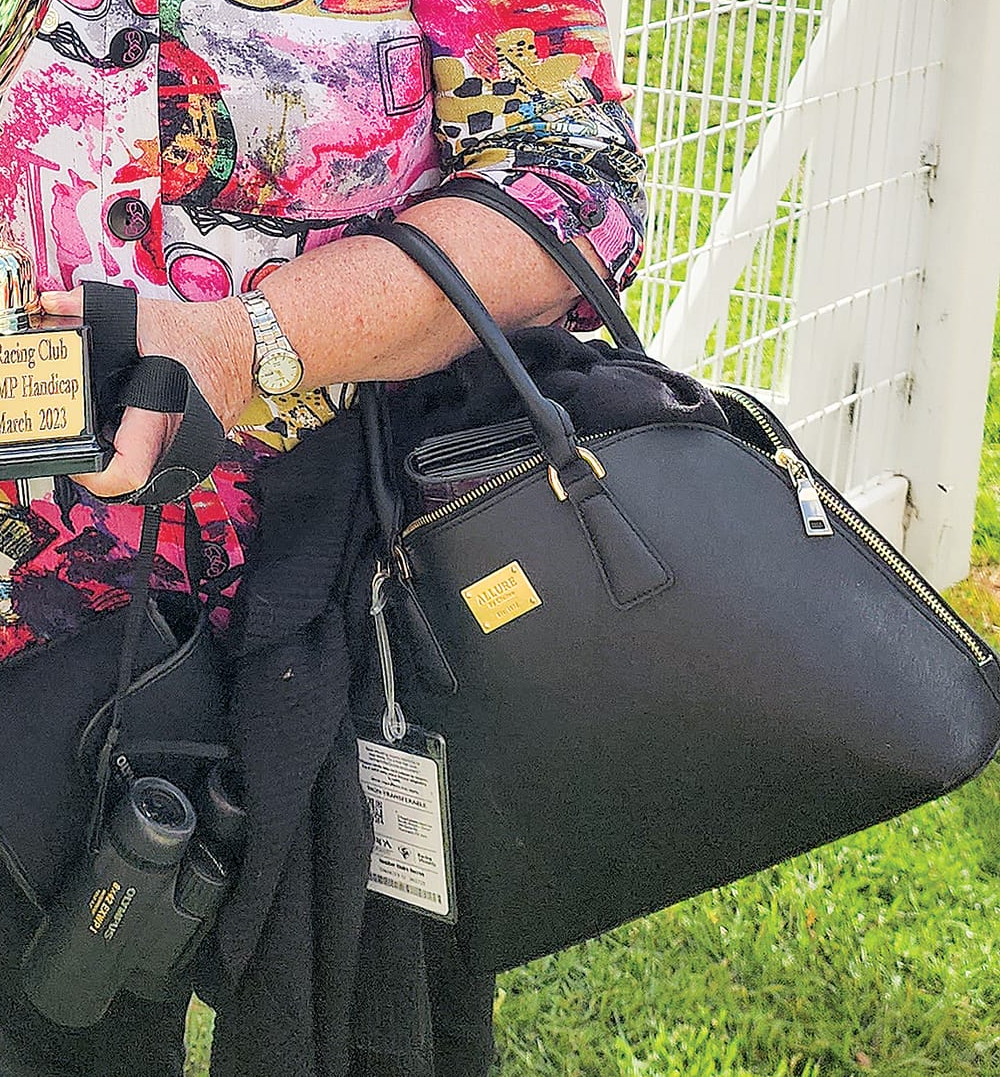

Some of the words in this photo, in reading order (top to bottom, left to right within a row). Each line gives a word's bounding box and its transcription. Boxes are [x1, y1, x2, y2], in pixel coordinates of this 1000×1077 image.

[38, 338, 68, 361] Club
[21, 373, 79, 400] Handicap
[39, 407, 67, 431] 2023
[477, 576, 518, 606] ALLURE
[103, 887, 137, 940] OLYMPUS
